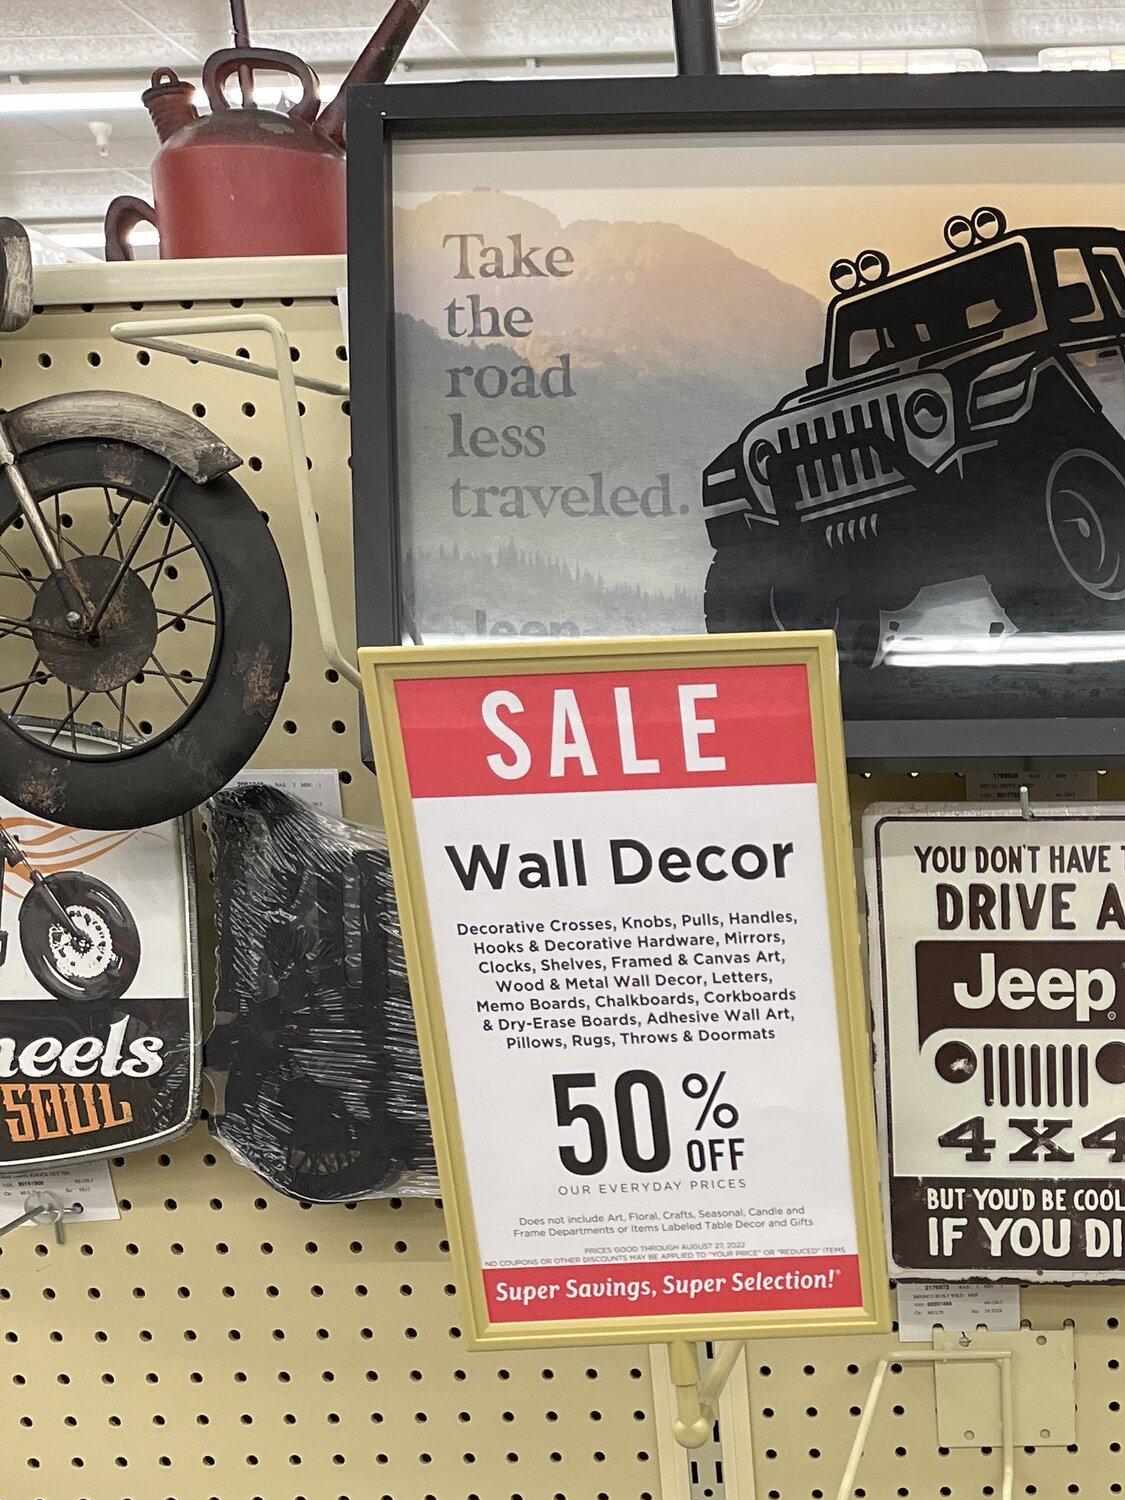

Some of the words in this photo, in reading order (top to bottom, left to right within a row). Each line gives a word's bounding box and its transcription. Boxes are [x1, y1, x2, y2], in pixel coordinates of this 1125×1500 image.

[442, 233, 574, 280] Take
[443, 294, 533, 338] the
[445, 354, 577, 399] road
[447, 413, 545, 458] less
[450, 474, 690, 519] traveled.
[482, 684, 726, 779] SALE
[444, 838, 588, 891] Wall
[609, 838, 794, 885] Decor
[914, 846, 965, 873] YOU
[975, 845, 1042, 874] DON'T
[1049, 846, 1111, 874] HAVE
[936, 883, 1076, 930] DRIVE
[456, 920, 545, 936] Decorative
[549, 919, 617, 932] Crosses,
[621, 915, 677, 930] Knobs,
[681, 912, 724, 928] Pulls,
[729, 910, 798, 925] Handles,
[473, 940, 524, 955] Hooks
[528, 939, 540, 953] &
[544, 936, 632, 952] Decorative
[637, 934, 720, 948] Hardware,
[724, 931, 786, 945] Mirrors,
[478, 959, 536, 975] Clocks,
[540, 957, 607, 972] Shelves,
[611, 953, 673, 969] Framed
[677, 953, 688, 966] &
[693, 952, 751, 965] Canvas
[756, 950, 785, 965] Art,
[495, 978, 545, 993] Wood
[549, 978, 561, 991] &
[565, 975, 609, 990] Metal
[613, 974, 650, 988] Wall
[654, 974, 708, 987] Decor,
[712, 971, 773, 984] Letters,
[954, 952, 1117, 1022] Jeep
[476, 1000, 525, 1013] Memo
[529, 996, 590, 1011] Boards,
[595, 992, 699, 1008] Chalkboards,
[703, 988, 797, 1004] Corkboards
[483, 1019, 494, 1032] &
[498, 1017, 576, 1033] Dry-Erase
[581, 1013, 642, 1028] Boards,
[647, 1010, 720, 1025] Adhesive
[724, 1008, 760, 1022] Wall
[765, 1007, 795, 1022] Art,
[506, 1036, 567, 1050] Pillows,
[571, 1034, 616, 1048] Rugs,
[619, 1032, 678, 1045] Throws
[683, 1030, 693, 1043] &
[698, 1027, 776, 1042] Doormats
[0, 1083, 133, 1143] SOUL
[686, 1137, 745, 1173] OFF
[557, 1184, 591, 1196] OUR
[598, 1181, 682, 1194] EVERYDAY
[689, 1178, 746, 1190] PRICES
[927, 1187, 967, 1211] BUT
[972, 1187, 1037, 1212] YOU'D
[1044, 1187, 1068, 1211] BE
[513, 1229, 546, 1238] Frame
[548, 1226, 616, 1238] Departments
[617, 1226, 629, 1234] or
[631, 1224, 660, 1233] Items
[661, 1221, 703, 1232] Labeled
[704, 1220, 733, 1230] Table
[735, 1219, 766, 1229] Decor
[768, 1218, 788, 1228] and
[789, 1217, 814, 1227] Gifts
[518, 1217, 546, 1227] Does
[547, 1216, 566, 1225] not
[567, 1214, 605, 1224] include
[606, 1213, 627, 1222] Art,
[628, 1211, 661, 1221] Floral,
[662, 1210, 696, 1220] Crafts,
[698, 1208, 746, 1219] Seasonal,
[748, 1207, 784, 1217] Candle
[785, 1205, 805, 1215] and
[584, 1246, 613, 1255] PRICES
[613, 1245, 639, 1254] GOOD
[639, 1244, 680, 1252] THROUGH
[681, 1242, 713, 1251] AUGUST
[714, 1242, 725, 1250] 27,
[726, 1241, 746, 1249] 2022
[929, 1217, 968, 1257] IF
[978, 1217, 1072, 1257] YOU
[495, 1281, 560, 1306] Super
[565, 1277, 657, 1302] Savings,
[662, 1275, 727, 1299] Super
[731, 1269, 836, 1292] Selection!
